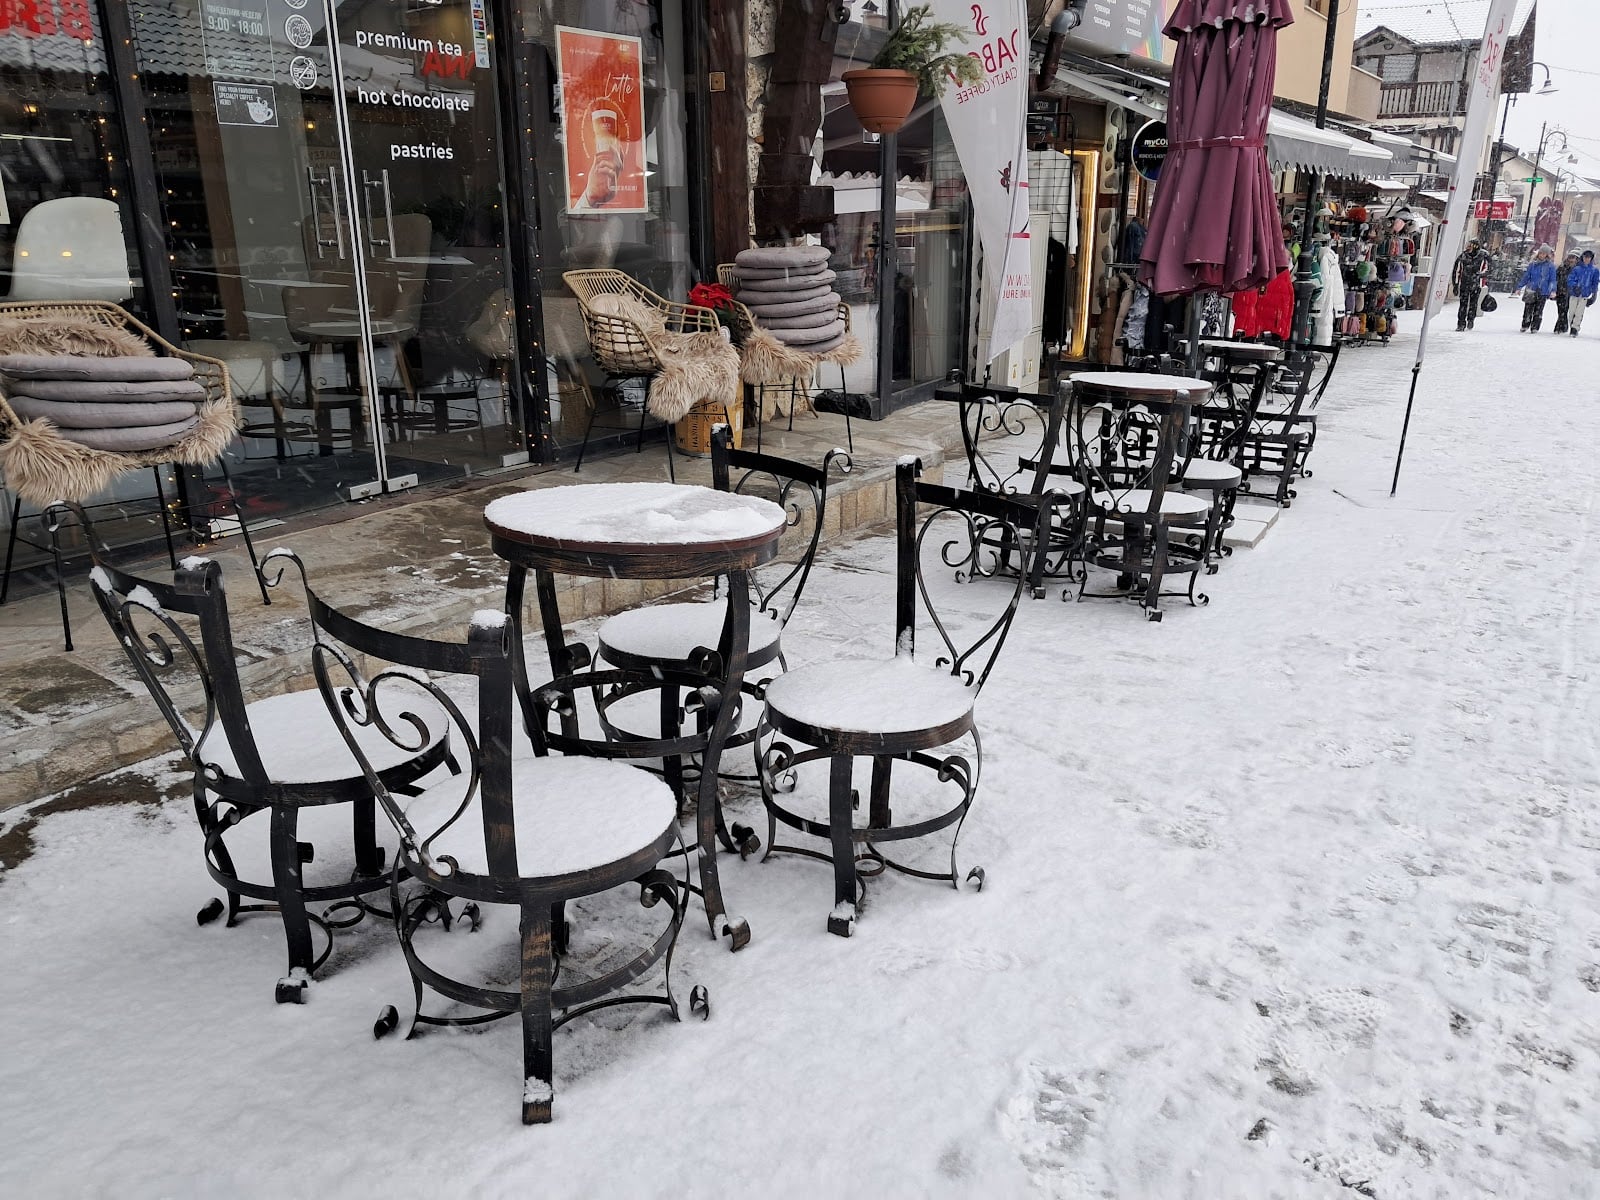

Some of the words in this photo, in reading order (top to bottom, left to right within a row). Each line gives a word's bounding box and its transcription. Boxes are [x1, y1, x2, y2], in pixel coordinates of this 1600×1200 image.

[208, 15, 230, 31] 9:00
[238, 20, 263, 36] 18:00
[355, 29, 434, 53] premium
[437, 39, 463, 57] tea
[357, 86, 389, 107] hot
[392, 89, 470, 112] chocolate
[604, 72, 634, 103] Latte
[390, 142, 454, 161] pastries
